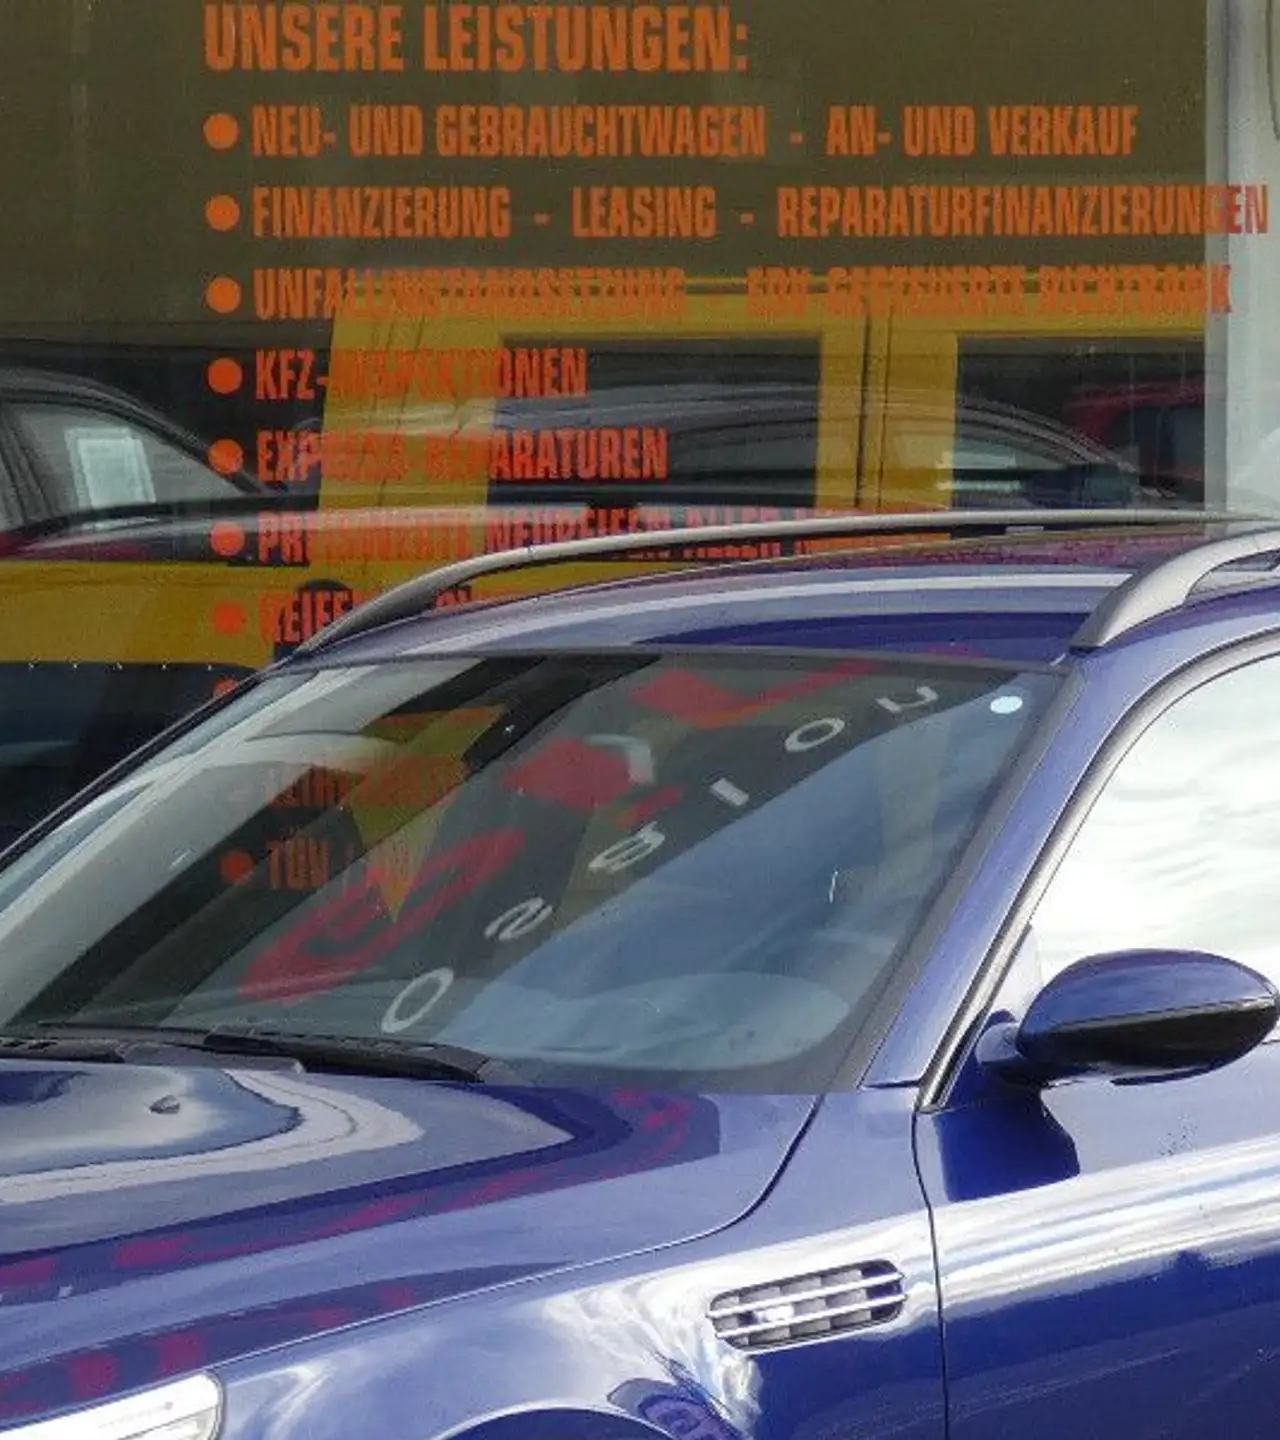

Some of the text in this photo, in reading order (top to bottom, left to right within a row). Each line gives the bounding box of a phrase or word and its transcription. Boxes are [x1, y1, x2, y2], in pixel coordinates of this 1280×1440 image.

[204, 3, 749, 72] UNSERE LEISTUNGEN:
[251, 105, 337, 157] NEU-
[348, 105, 422, 157] UND
[436, 105, 767, 157] GEBRAUCHTWAGEN
[825, 105, 891, 156] AN-
[903, 105, 975, 156] UND
[987, 105, 1139, 156] VERKAUF
[252, 186, 512, 238] FINANZIERUNG
[571, 186, 718, 238] LEASING
[776, 185, 1270, 238] REPARATURFINANZIERUNGEN
[255, 348, 588, 401] KFZ-INSPEKTIONEN
[425, 427, 669, 481] REPARATUREN
